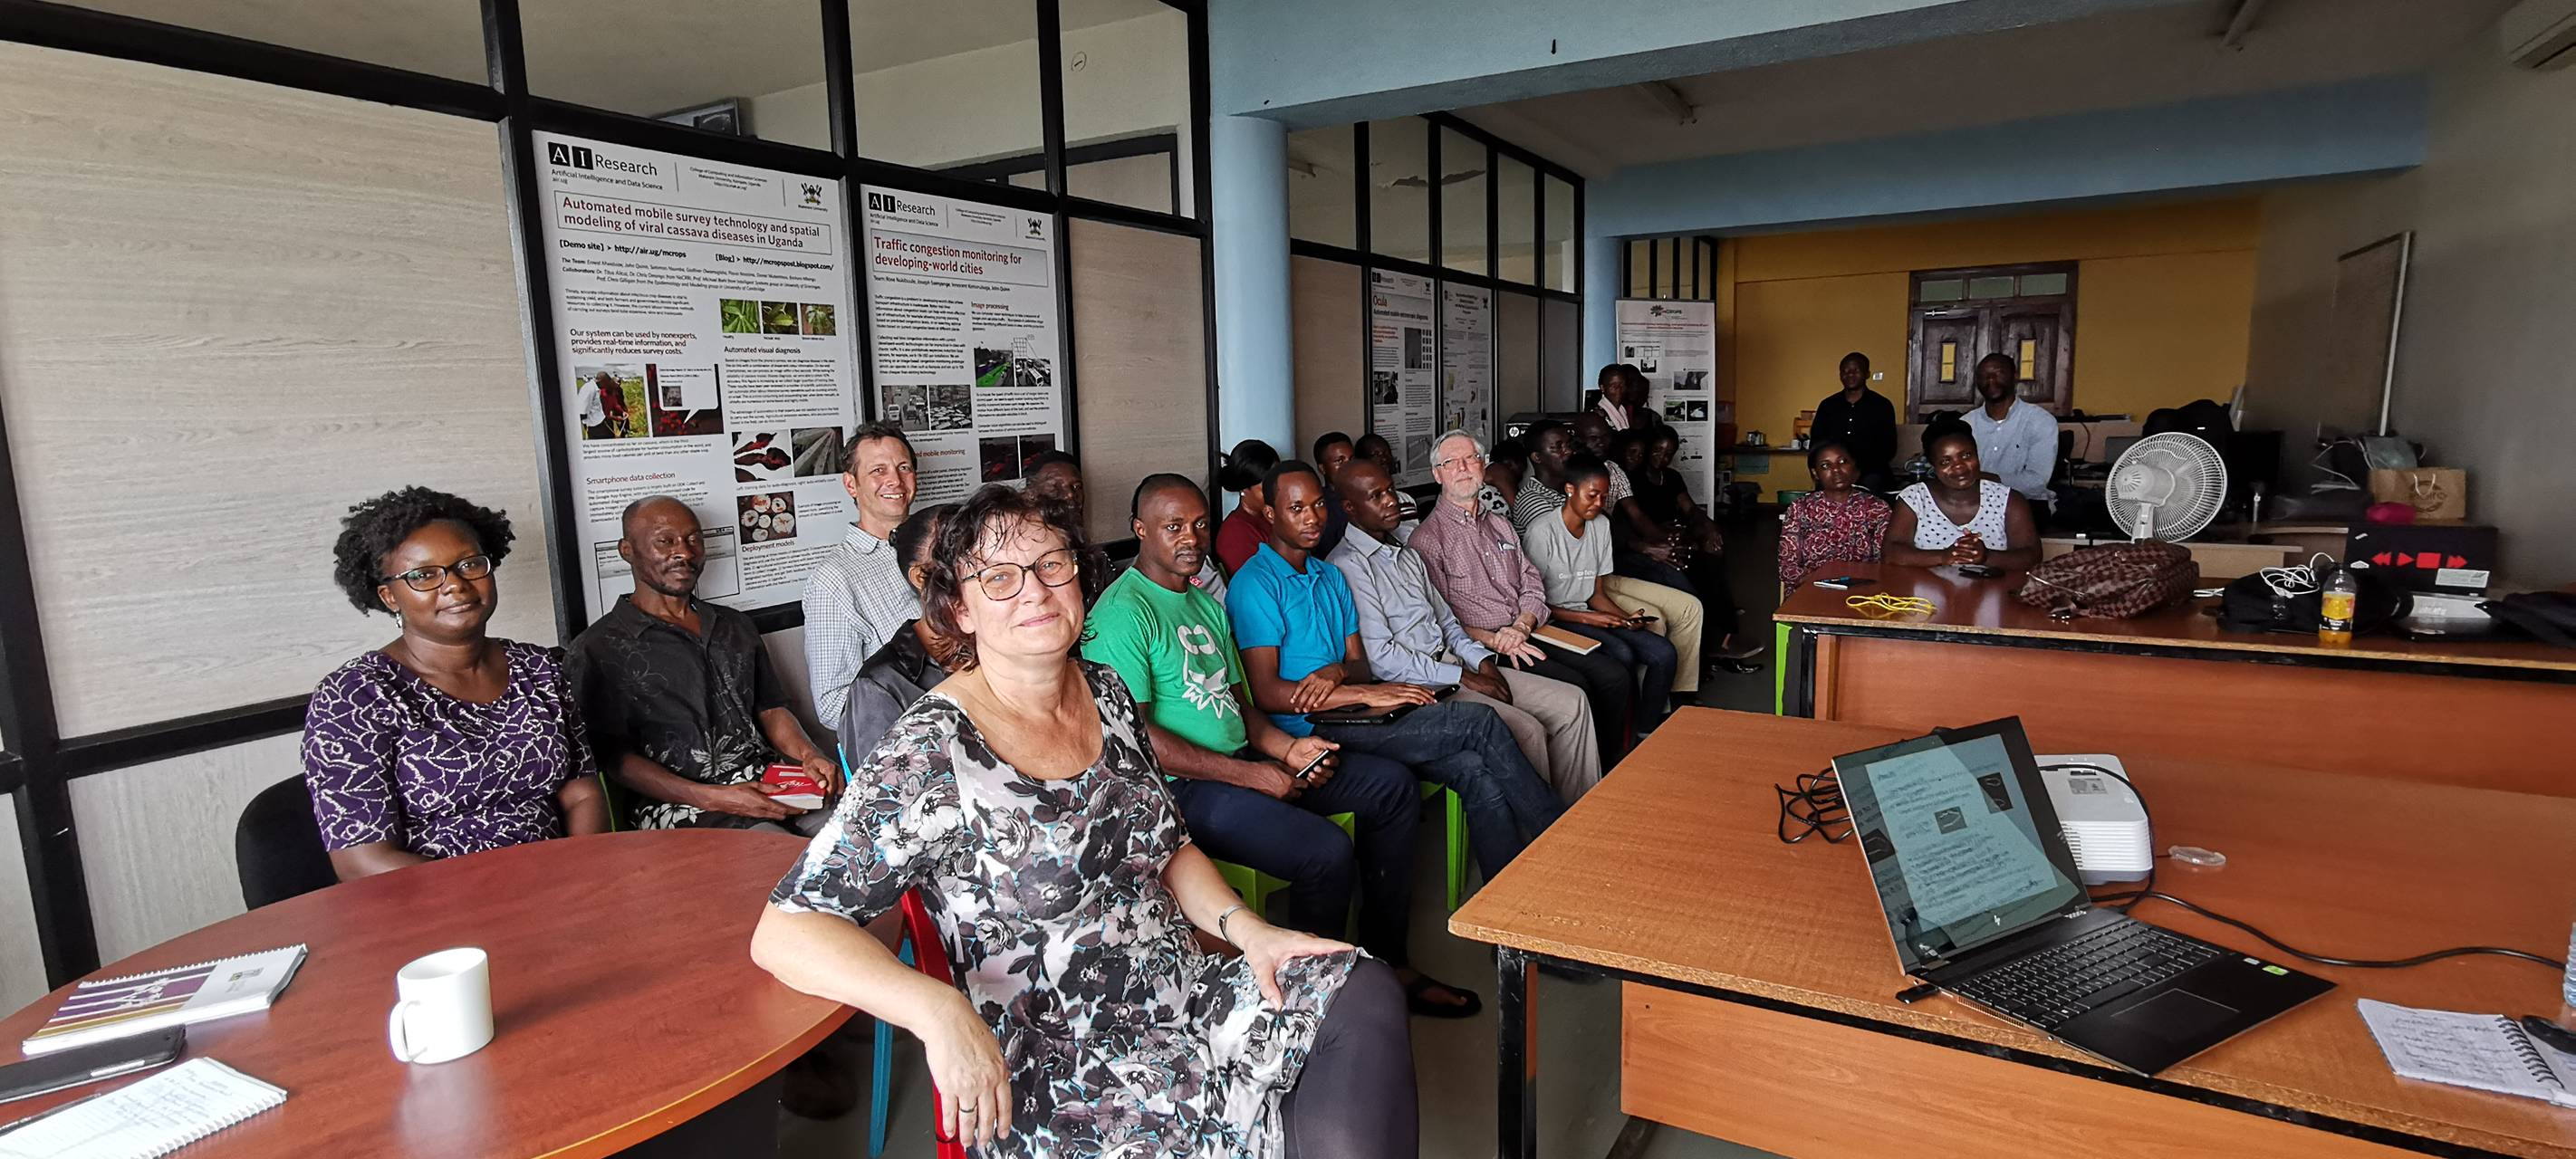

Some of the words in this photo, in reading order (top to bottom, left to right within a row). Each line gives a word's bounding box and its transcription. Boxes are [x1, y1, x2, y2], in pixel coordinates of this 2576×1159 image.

[595, 154, 658, 176] Research
[552, 169, 577, 177] Artificial
[579, 172, 613, 184] Intelligence
[628, 179, 640, 187] Data
[642, 181, 663, 190] Science
[897, 200, 936, 216] Research
[563, 196, 631, 216] Automated
[635, 206, 673, 220] mobile
[676, 213, 711, 226] survey
[714, 216, 768, 233] technology
[771, 223, 787, 234] and
[790, 225, 820, 237] spatial
[564, 215, 622, 232] modeling
[624, 219, 637, 230] of
[639, 221, 664, 234] viral
[667, 225, 709, 238] cassava
[712, 229, 755, 244] diseases
[756, 233, 766, 244] in
[768, 235, 803, 248] Uganda
[560, 239, 586, 249] [Demo
[588, 240, 604, 252] site]
[874, 236, 908, 252] Traffic
[909, 242, 960, 258] congestion
[962, 249, 1009, 265] monitoring
[1010, 253, 1023, 264] for
[716, 253, 735, 263] [Blog]
[875, 254, 958, 273] developing-world
[959, 263, 984, 275] cities
[971, 301, 985, 310] Image
[985, 302, 1009, 311] processing
[570, 329, 584, 337] Our
[586, 330, 611, 339] system
[635, 330, 650, 339] used
[651, 331, 660, 340] by
[661, 332, 697, 340] nonexperts,
[572, 338, 602, 346] provides
[602, 339, 634, 347] real-time
[634, 340, 674, 348] information,
[572, 345, 615, 356] significantly
[615, 346, 642, 355] reduces
[642, 348, 664, 356] survey
[665, 347, 684, 355] costs.
[725, 346, 757, 354] Automated
[775, 347, 802, 355] diagnosis
[940, 448, 966, 457] monitoring
[586, 476, 629, 486] Smartphone
[630, 474, 644, 483] data
[645, 472, 676, 482] collection
[742, 542, 775, 553] Deployment
[775, 540, 795, 548] models
